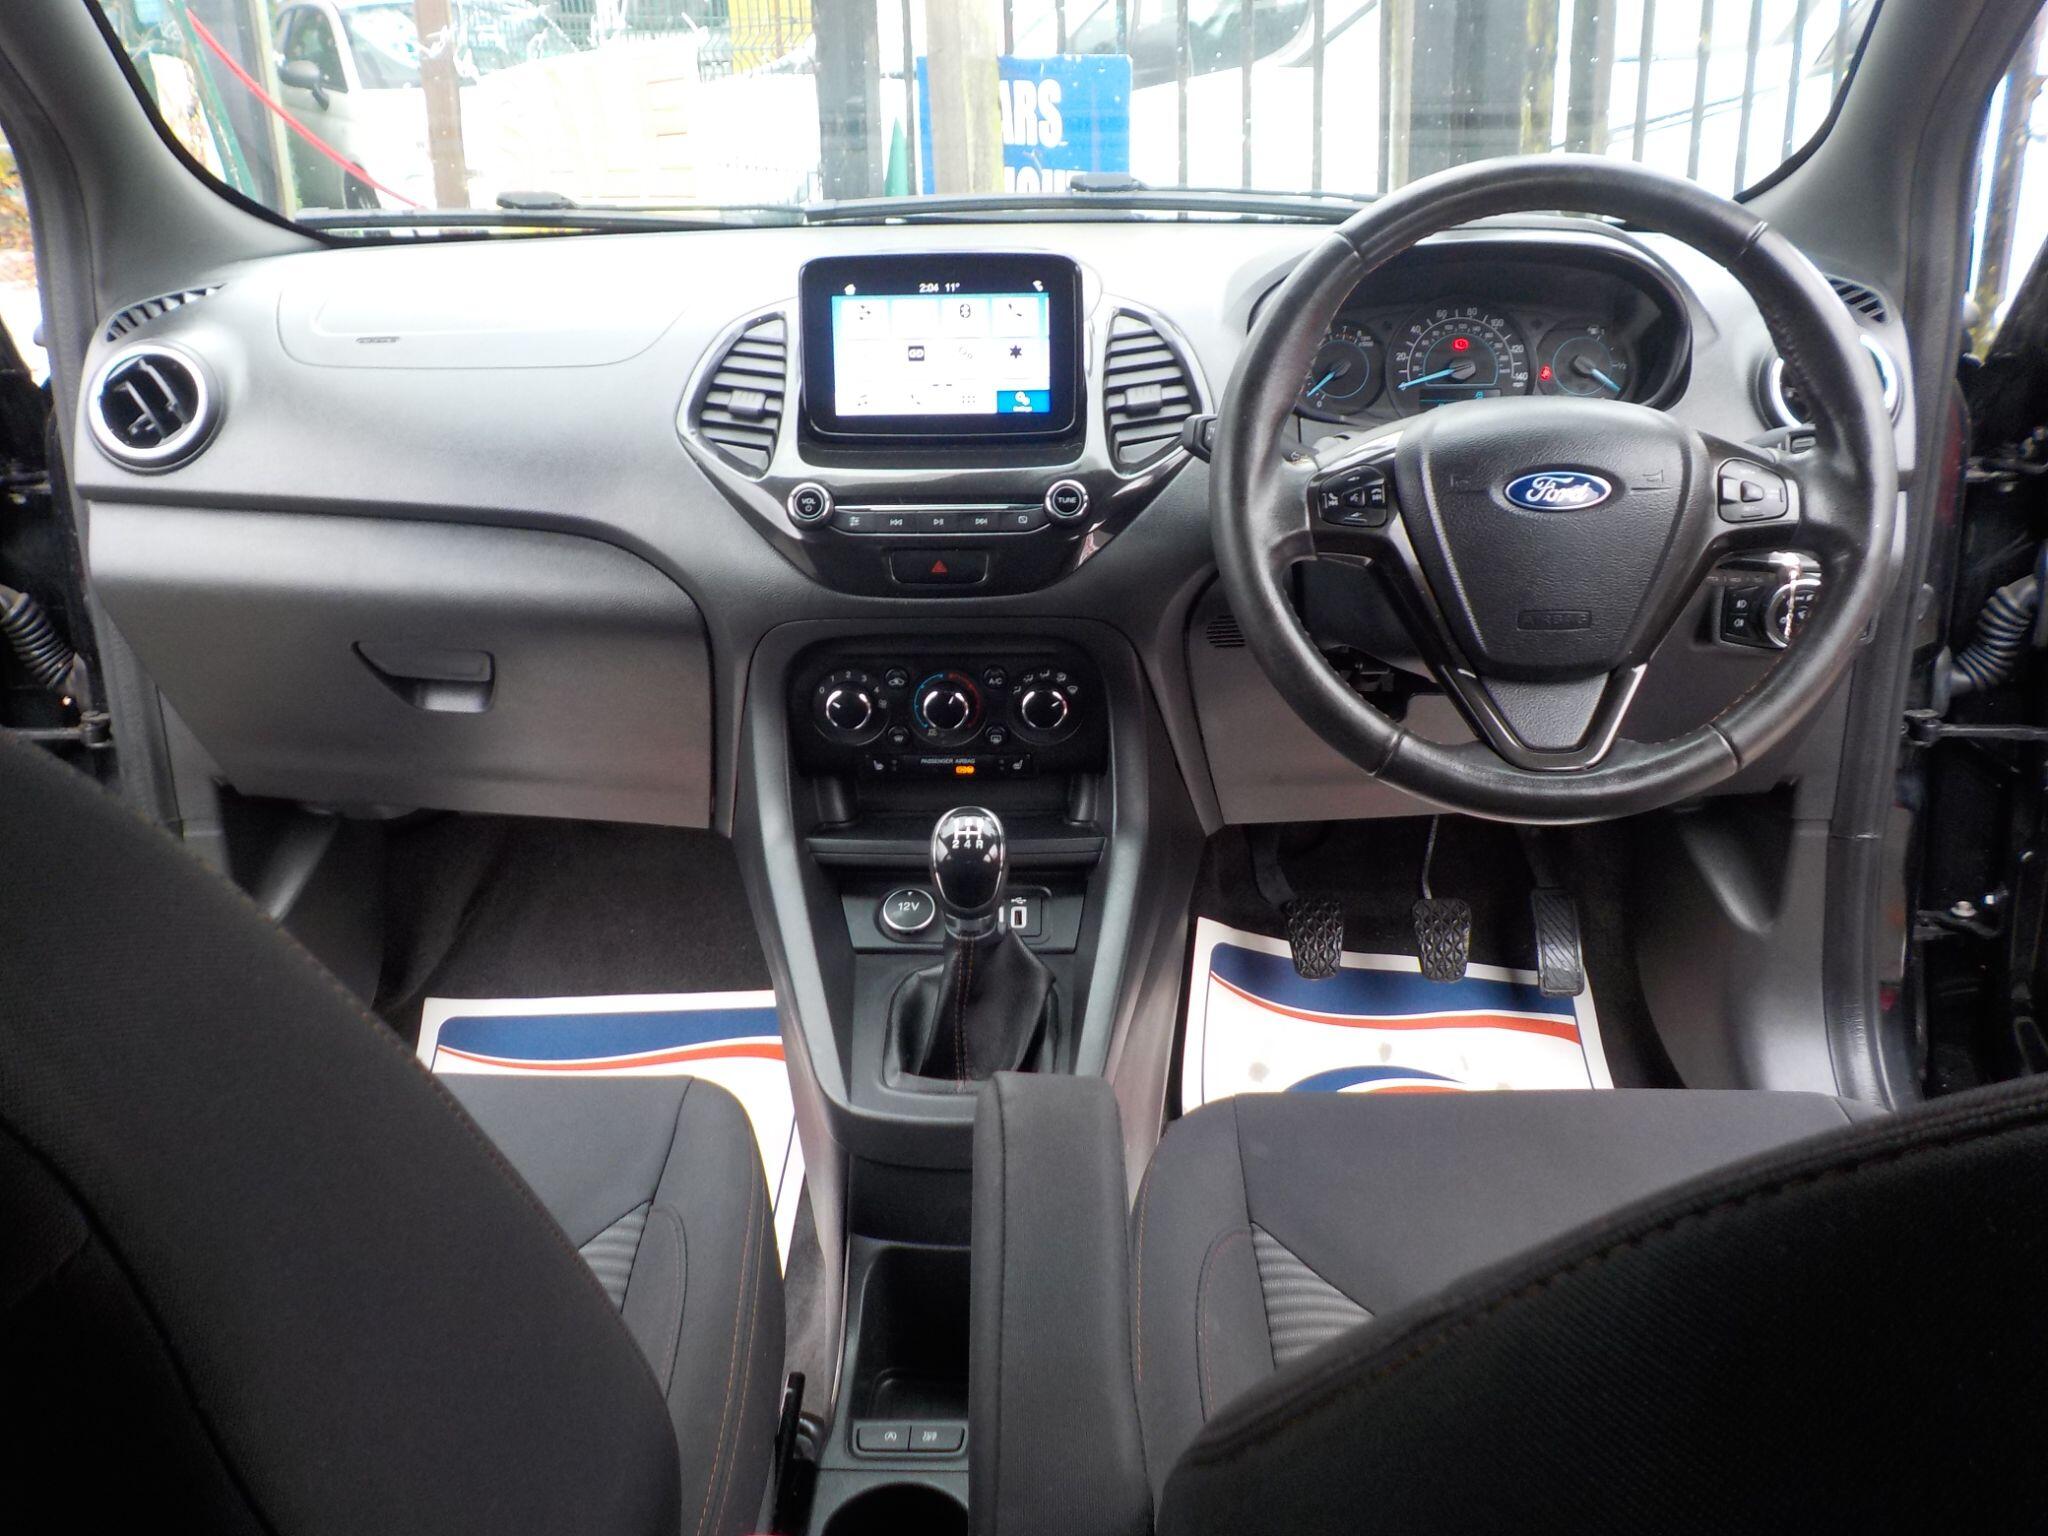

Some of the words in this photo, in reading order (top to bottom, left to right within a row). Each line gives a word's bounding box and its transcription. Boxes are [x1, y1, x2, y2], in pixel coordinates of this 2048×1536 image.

[1000, 79, 1063, 149] ARS
[919, 283, 939, 293] 2:04
[1396, 352, 1406, 361] 20
[1411, 325, 1422, 334] 40
[1467, 307, 1478, 316] 80
[1525, 476, 1591, 503] Ford
[801, 497, 816, 505] VOL
[952, 840, 960, 849] 2
[963, 840, 971, 849] 4
[975, 840, 984, 849] R
[898, 901, 920, 911] 12V
